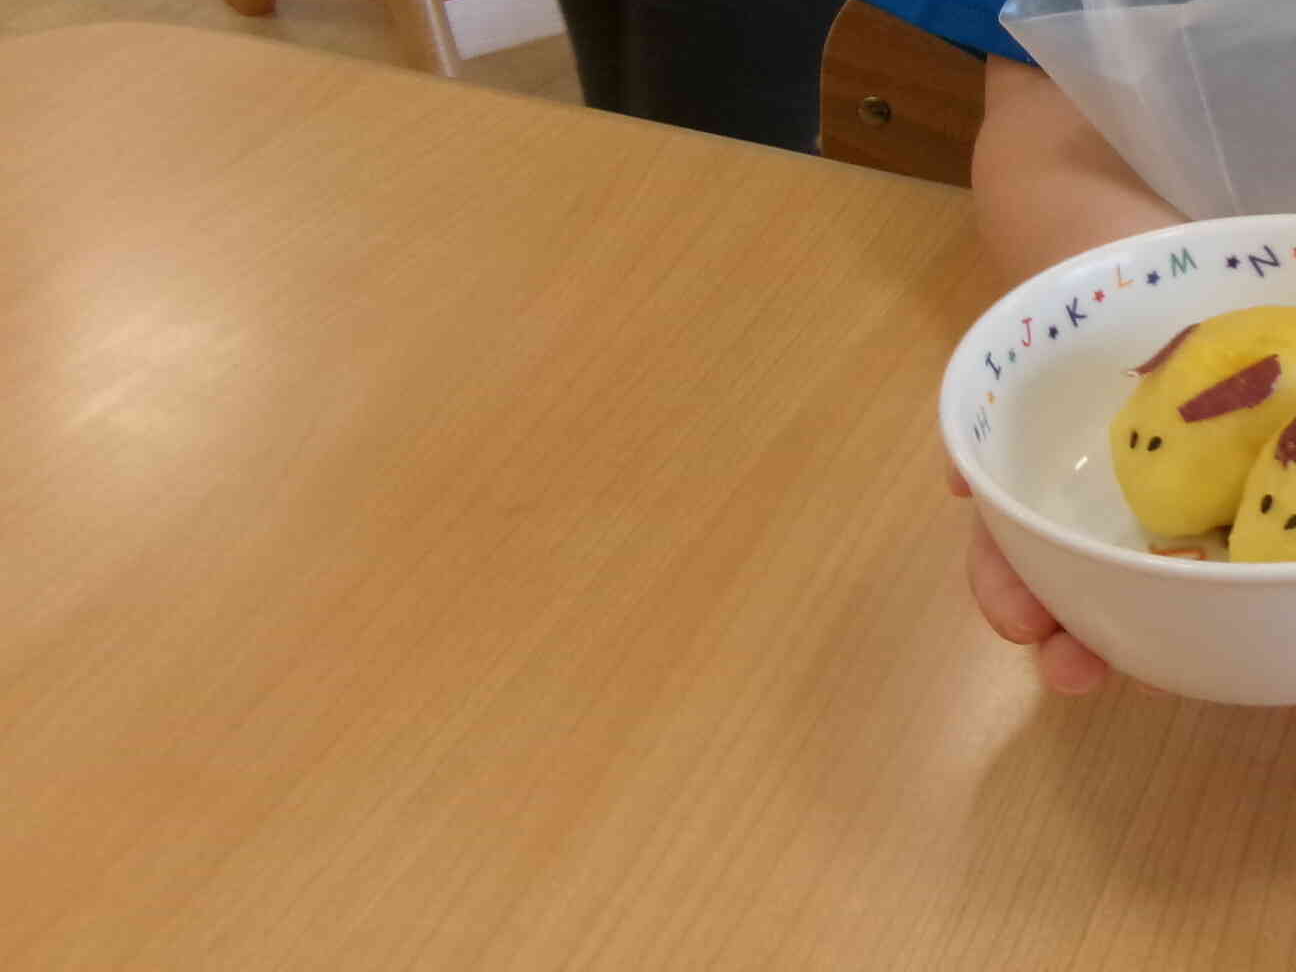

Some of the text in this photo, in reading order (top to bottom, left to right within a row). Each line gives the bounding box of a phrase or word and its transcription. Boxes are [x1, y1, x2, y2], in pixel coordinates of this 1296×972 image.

[1021, 317, 1032, 347] J
[1066, 297, 1087, 328] K
[1116, 264, 1134, 288] L
[1169, 247, 1198, 277] M
[1248, 245, 1281, 277] N
